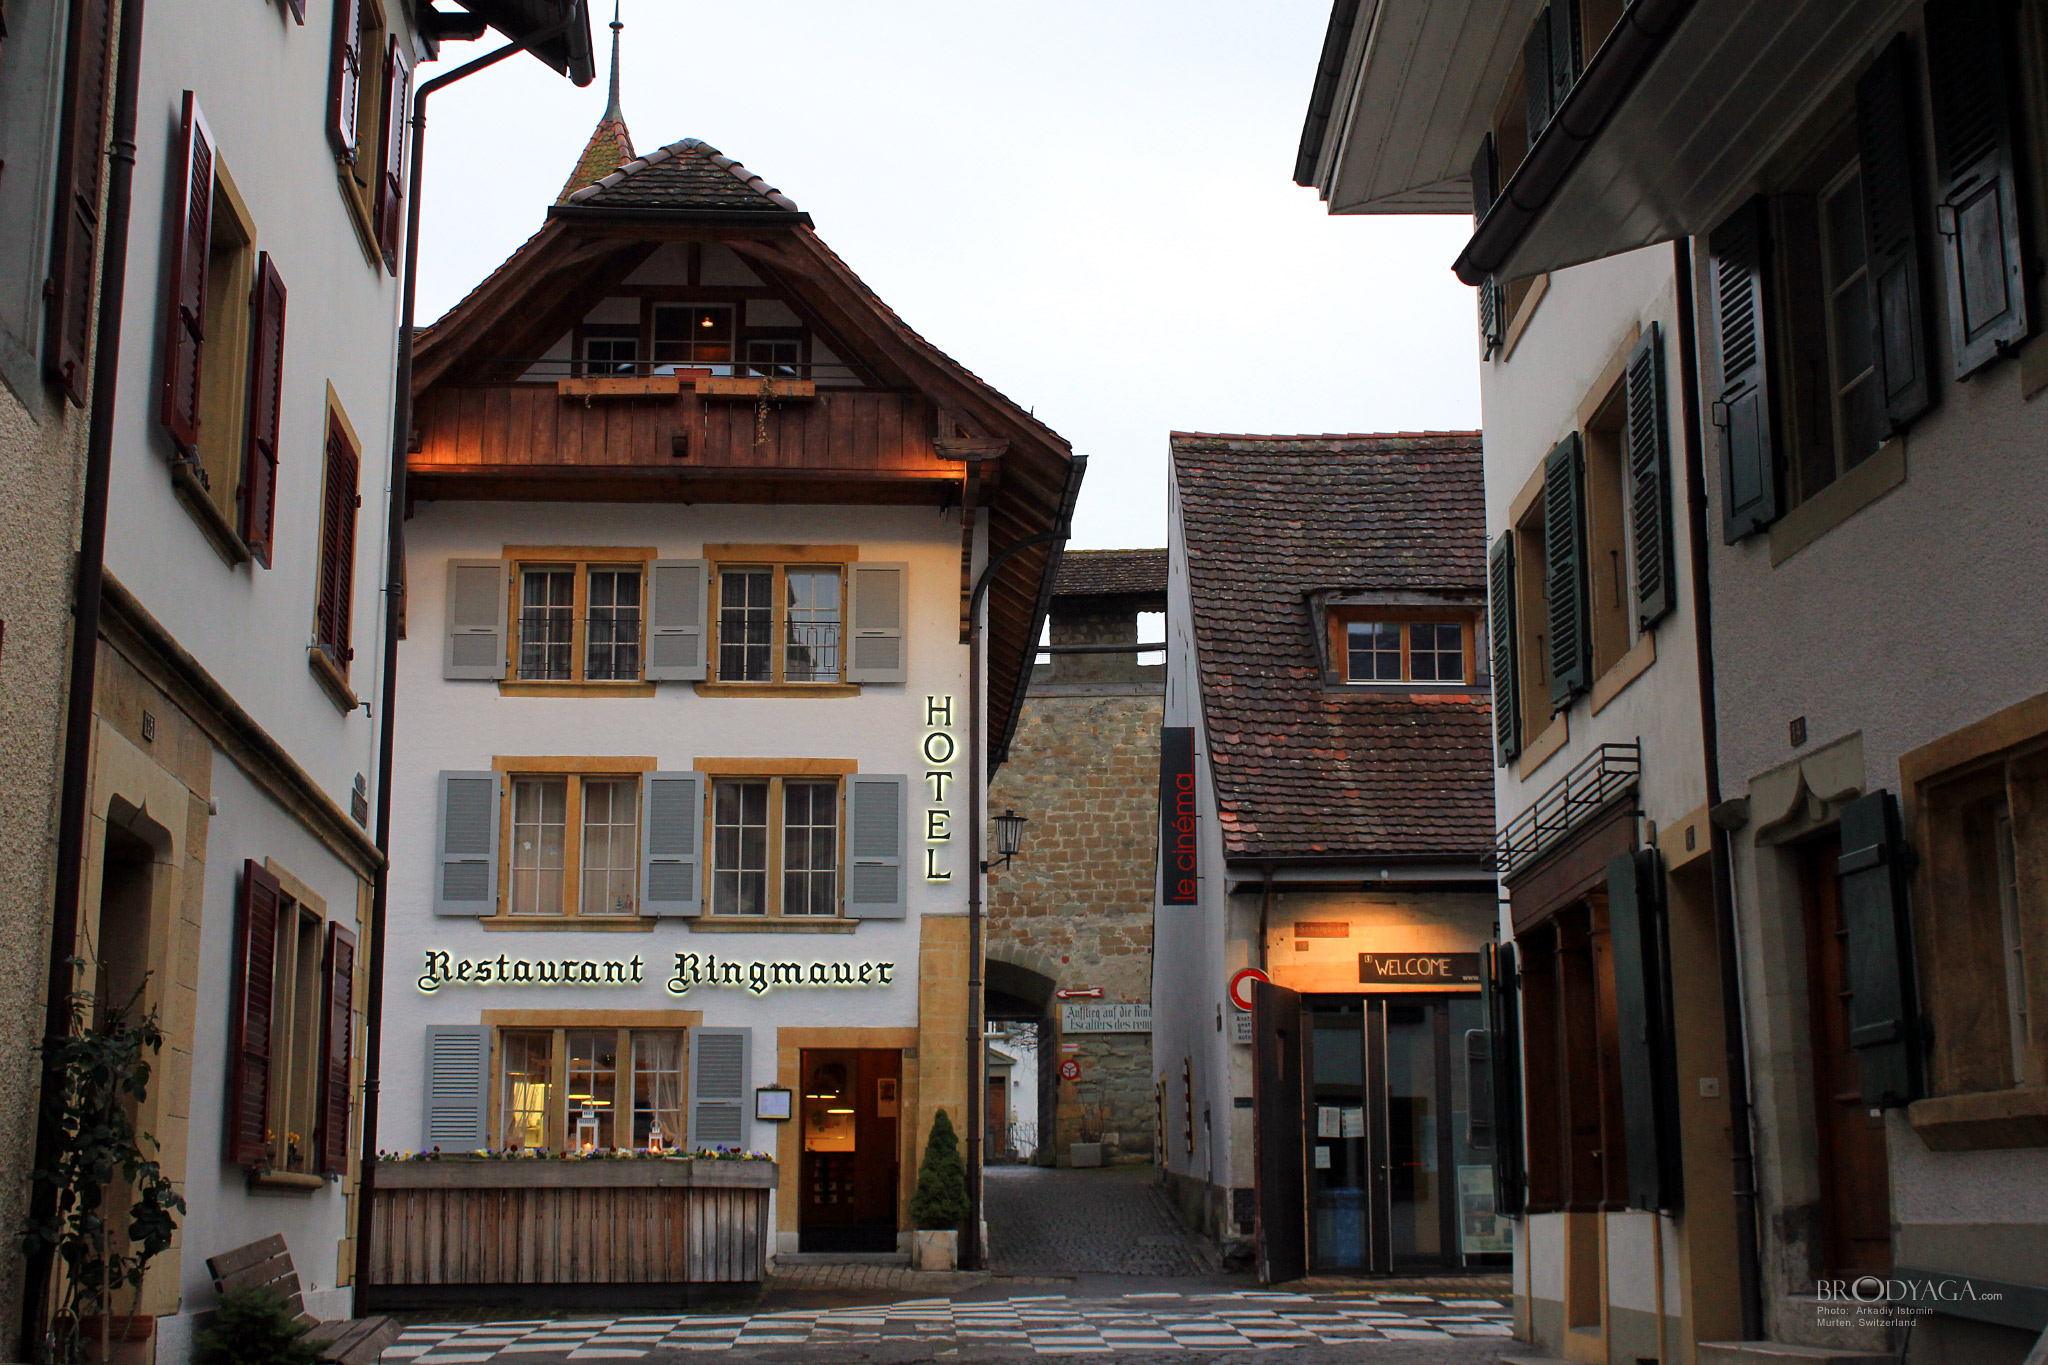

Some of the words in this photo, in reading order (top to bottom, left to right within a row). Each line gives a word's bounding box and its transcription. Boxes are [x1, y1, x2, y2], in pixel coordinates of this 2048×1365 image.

[923, 695, 955, 880] HOTEL
[1171, 773, 1195, 872] cinéma
[1172, 878, 1195, 900] le
[417, 951, 644, 992] Restaurant
[667, 952, 895, 994] Ringmauer
[1375, 957, 1453, 977] WELCOME
[1119, 1005, 1132, 1018] die
[1114, 1018, 1131, 1030] des
